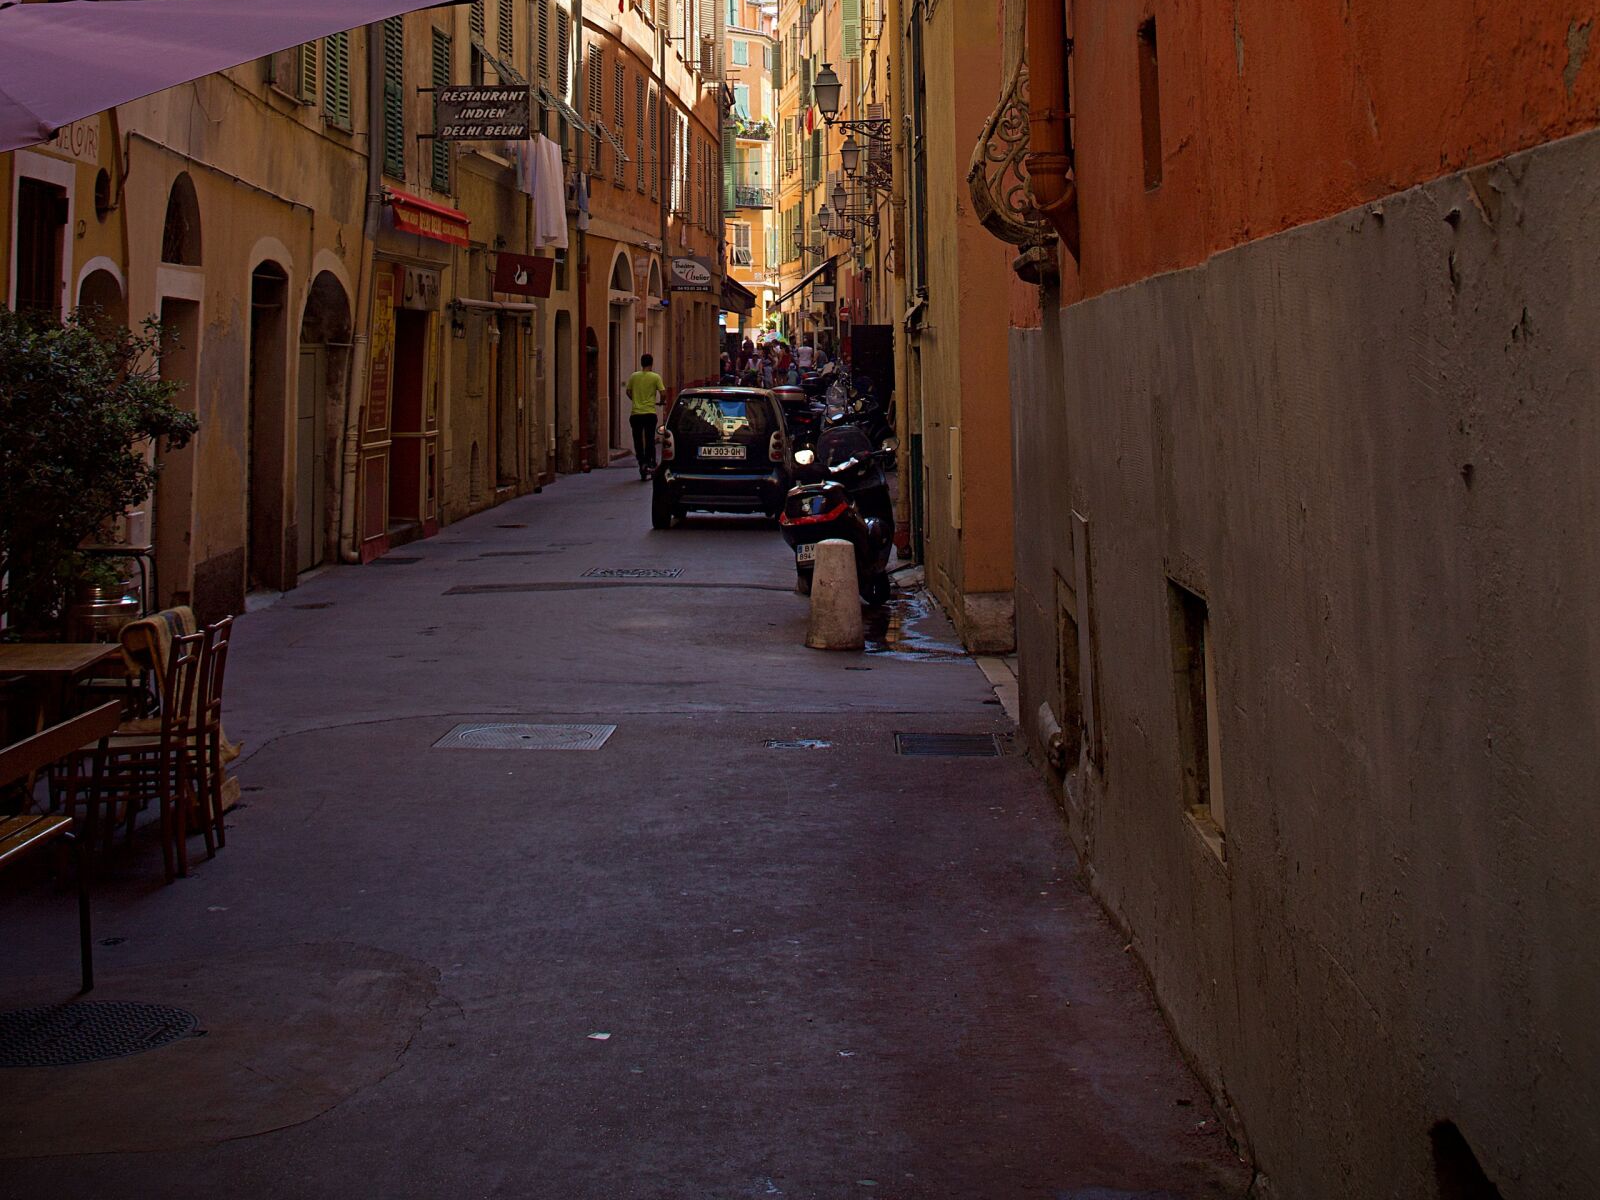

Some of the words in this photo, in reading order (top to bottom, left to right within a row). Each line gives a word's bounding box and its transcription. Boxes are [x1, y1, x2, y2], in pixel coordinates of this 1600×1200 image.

[441, 91, 526, 101] RESTAURANT
[460, 108, 506, 119] INDIEN
[442, 126, 482, 136] DELHI
[484, 126, 524, 136] BELHI
